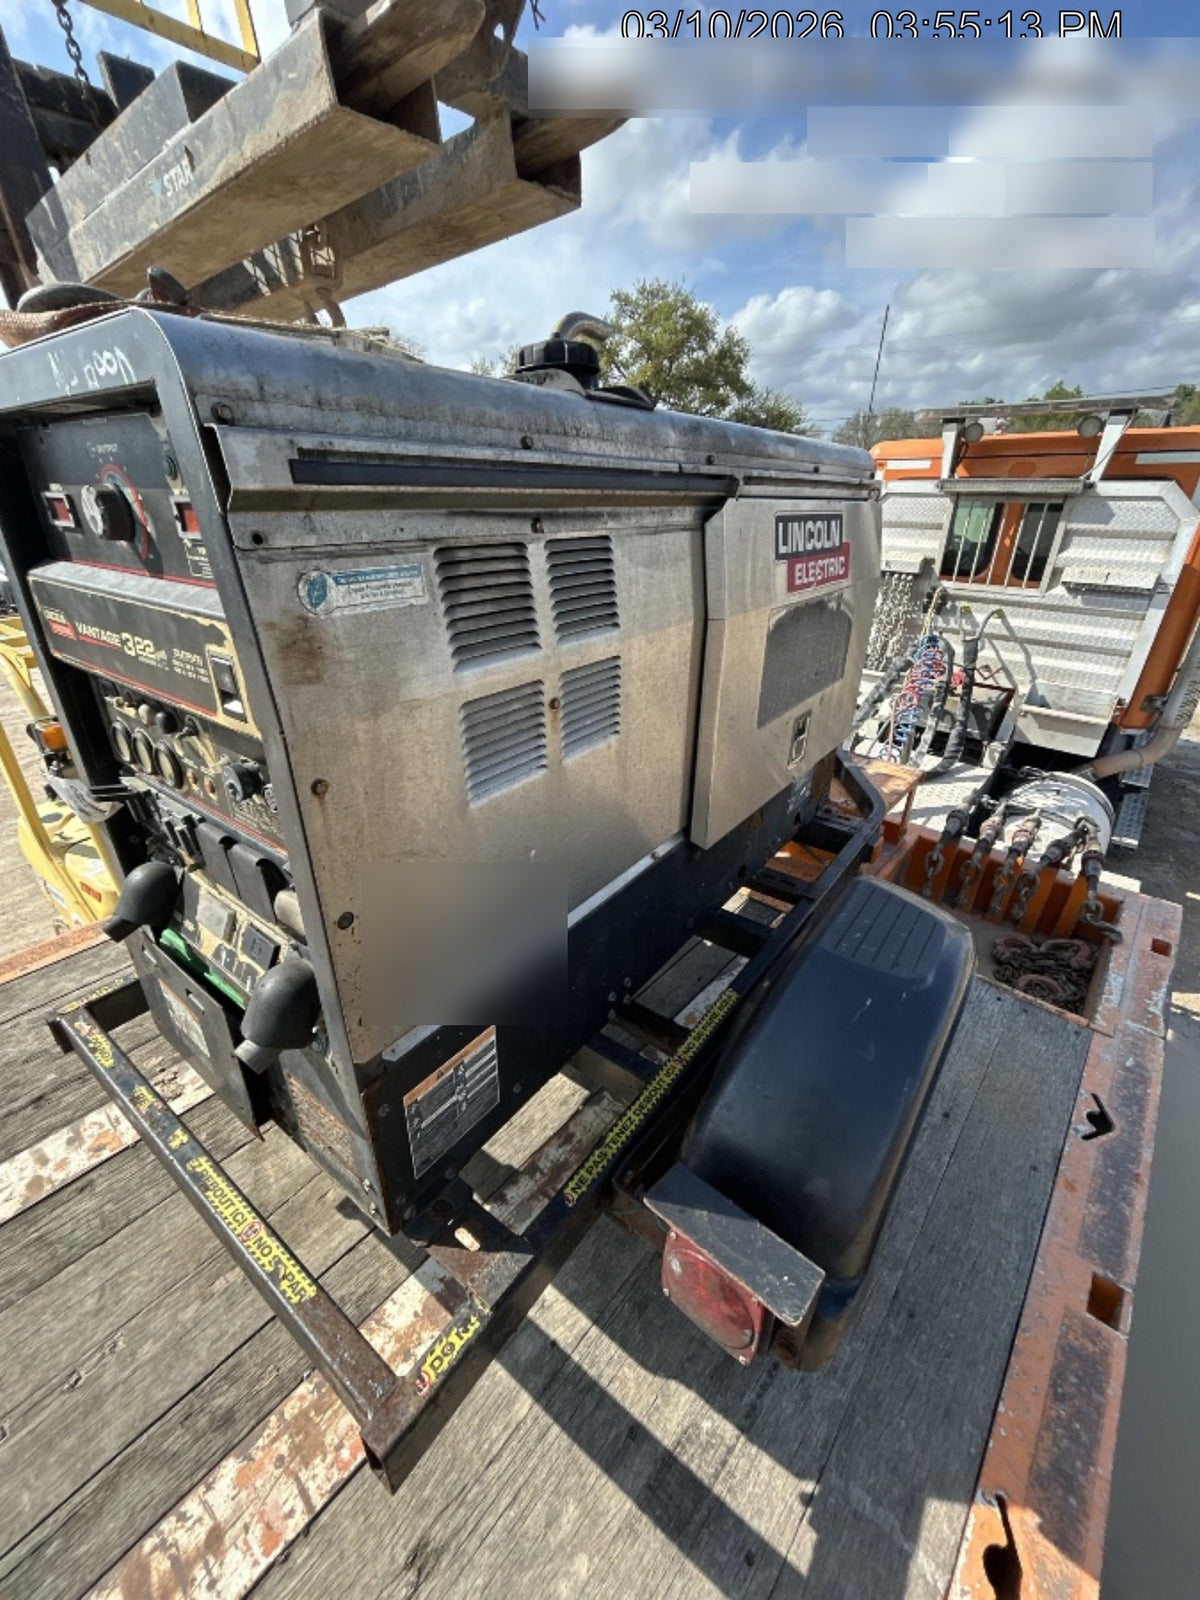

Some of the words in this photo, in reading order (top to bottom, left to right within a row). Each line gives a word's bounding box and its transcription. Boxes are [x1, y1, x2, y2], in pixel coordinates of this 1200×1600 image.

[778, 520, 839, 553] LINCOLN
[795, 556, 845, 585] ELECTRIC
[228, 1208, 248, 1227] ICI
[253, 1236, 273, 1258] NO
